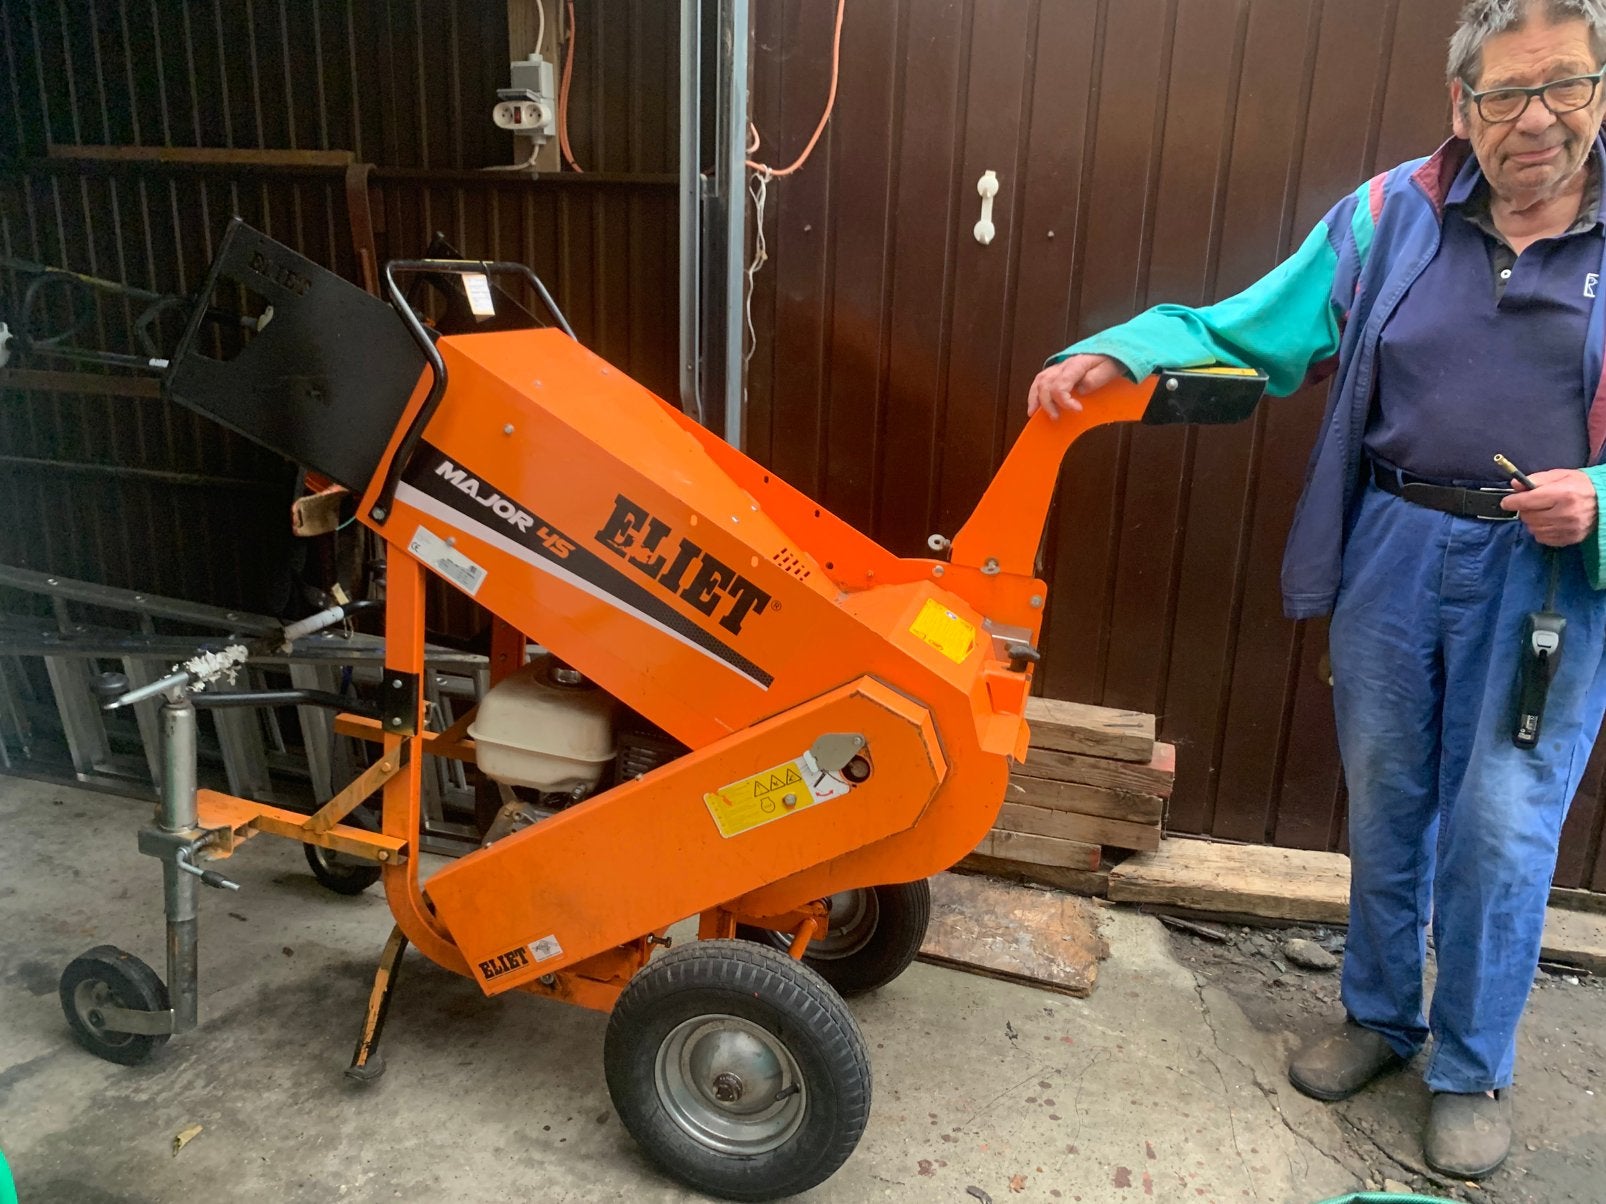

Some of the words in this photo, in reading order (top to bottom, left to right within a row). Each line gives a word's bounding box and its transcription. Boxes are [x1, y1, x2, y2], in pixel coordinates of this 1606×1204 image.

[435, 460, 534, 533] MAJOR
[536, 528, 577, 559] 45
[594, 494, 772, 636] ELIET
[478, 946, 529, 979] ELIET
